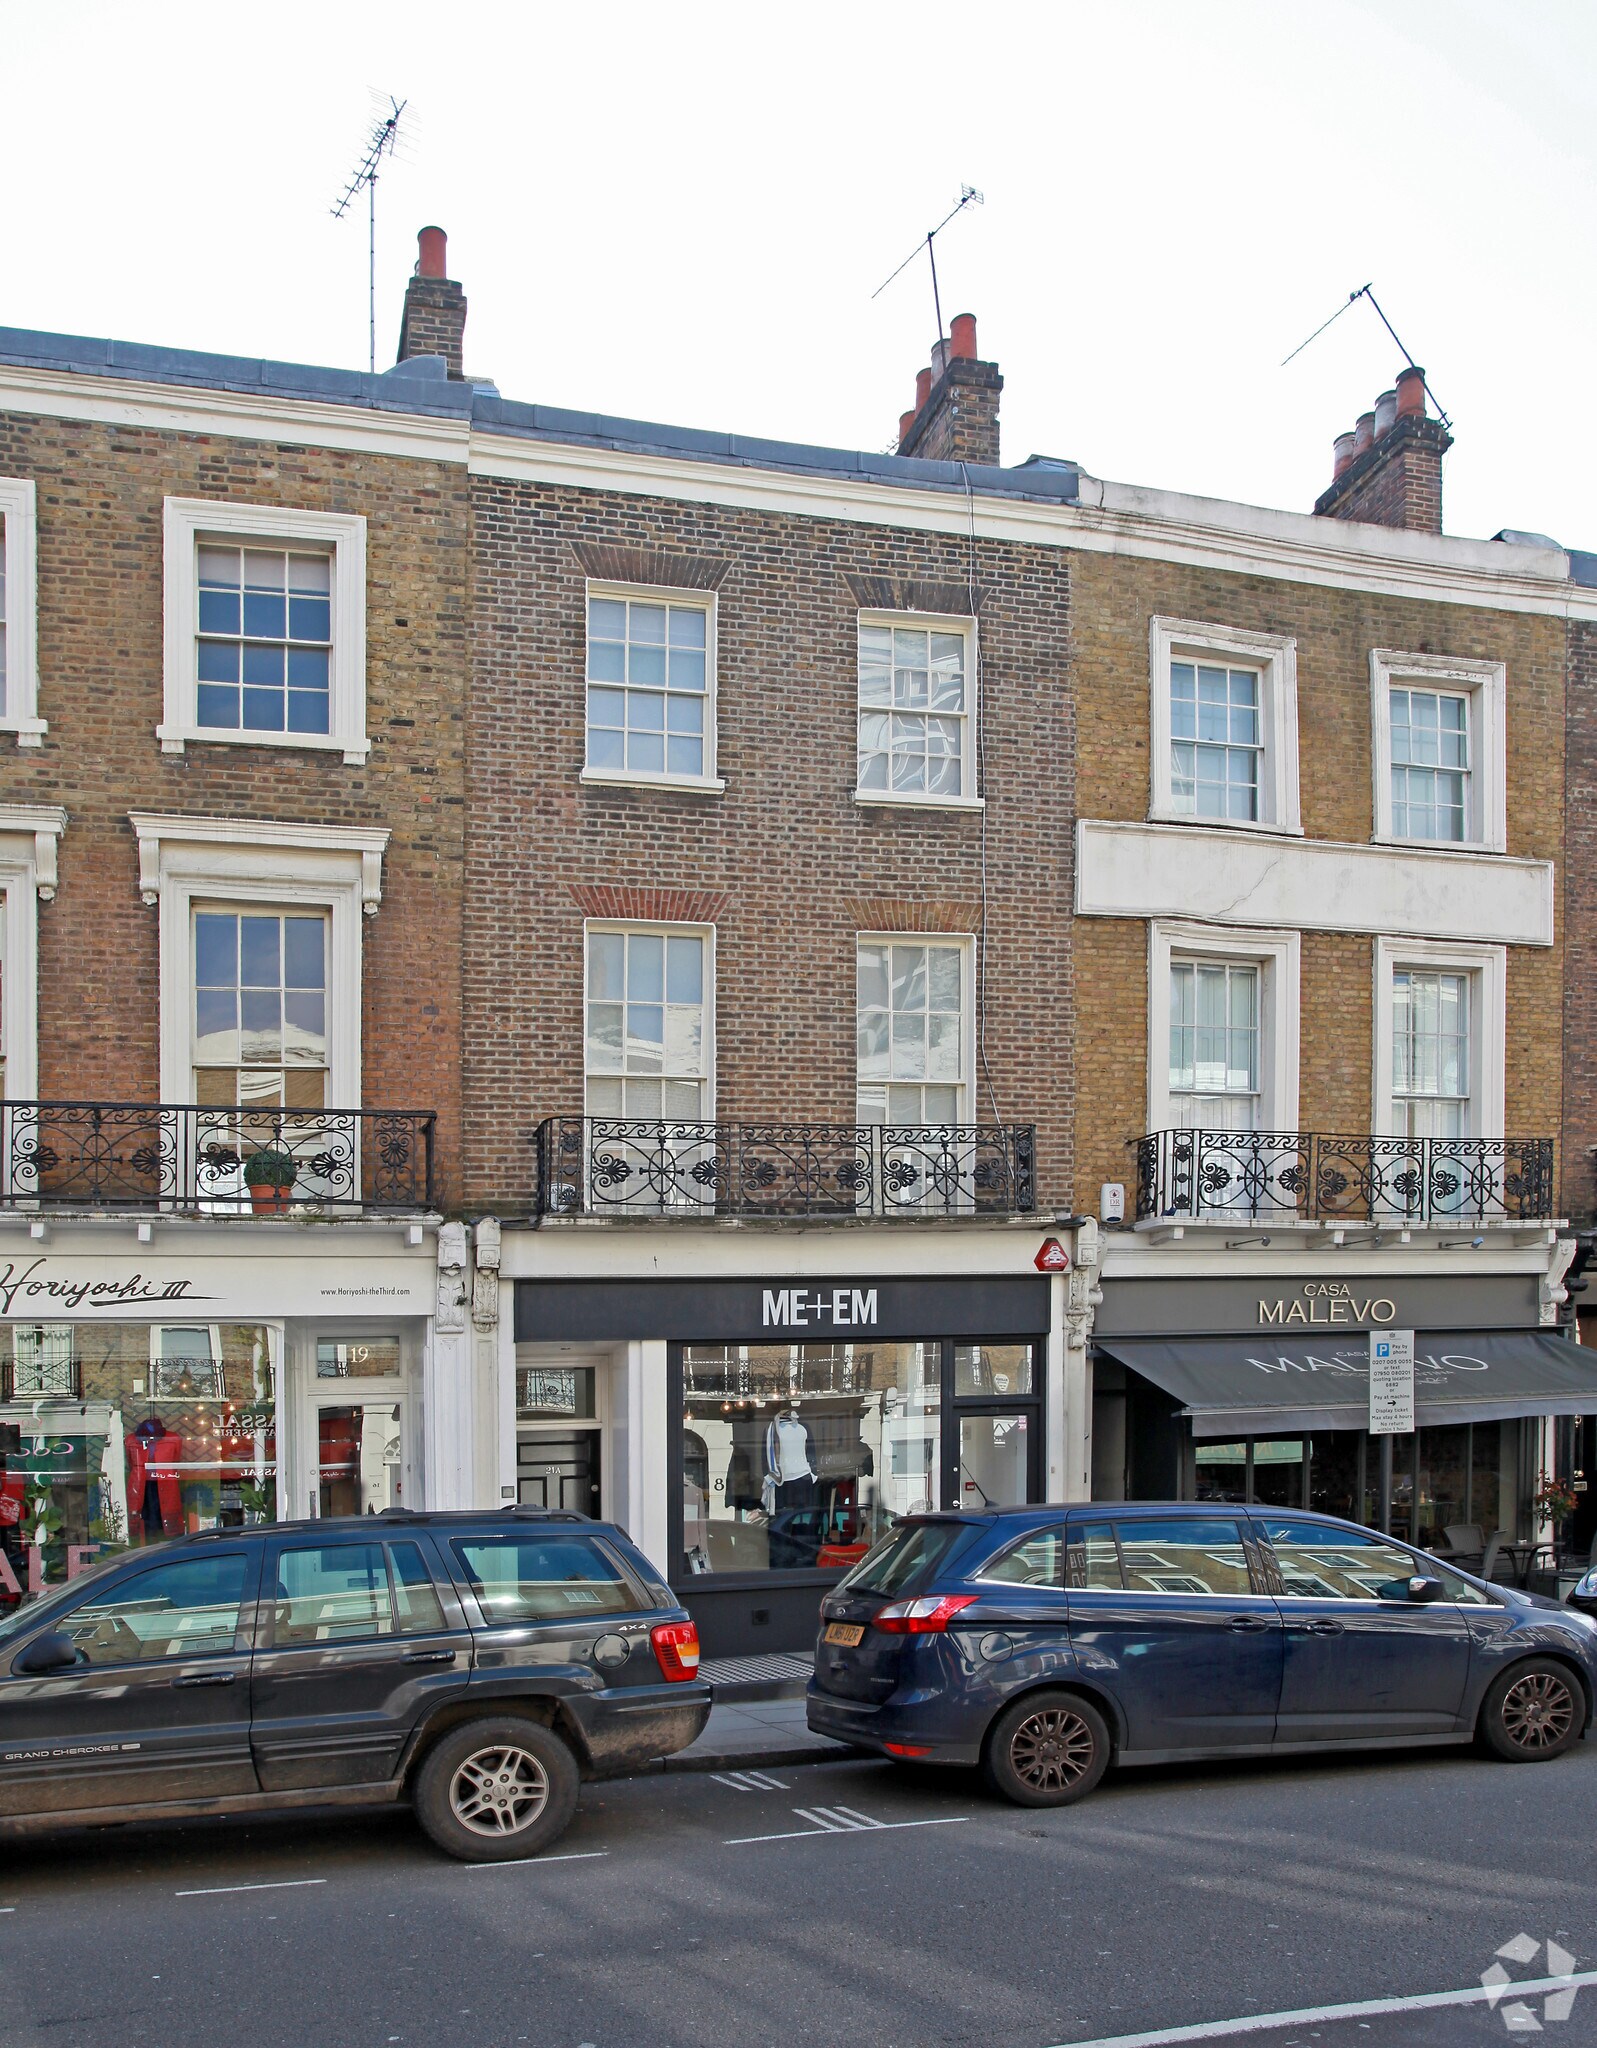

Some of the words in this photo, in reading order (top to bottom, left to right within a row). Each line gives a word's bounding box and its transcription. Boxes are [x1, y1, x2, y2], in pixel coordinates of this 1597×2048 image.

[0, 1257, 161, 1315] Horiyoshi
[320, 1286, 411, 1297] www.Horiyoshi-theThird.com
[1303, 1283, 1351, 1297] CASA
[762, 1289, 878, 1326] ME+EM
[1258, 1299, 1397, 1324] MALEVO
[350, 1346, 369, 1363] 19
[545, 1466, 562, 1474] 21A
[5, 1751, 50, 1760] GRAND
[52, 1744, 119, 1756] CHEROKEE
